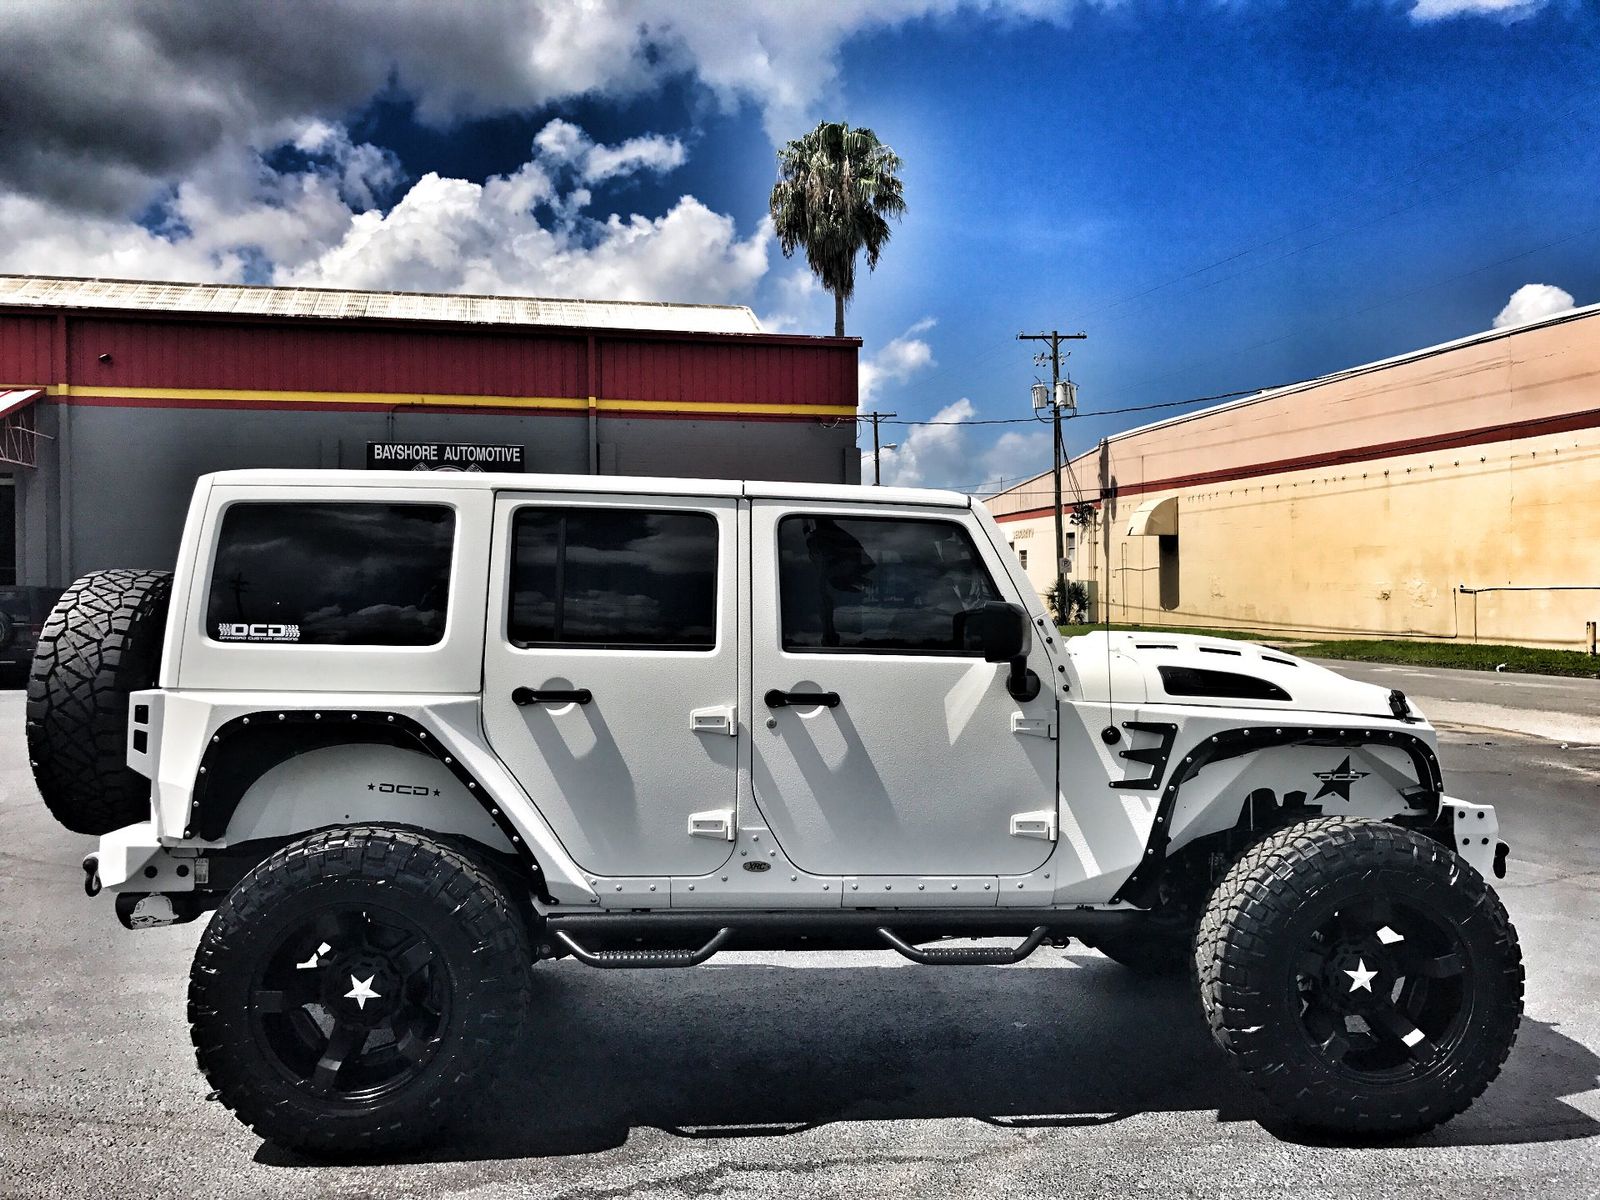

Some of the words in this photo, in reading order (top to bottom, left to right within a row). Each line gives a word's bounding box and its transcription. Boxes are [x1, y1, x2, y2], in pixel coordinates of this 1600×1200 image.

[374, 444, 438, 460] BAYSHORE
[444, 446, 521, 462] AUTOMOTIVE
[231, 623, 286, 636] OCD
[379, 783, 429, 796] OCD
